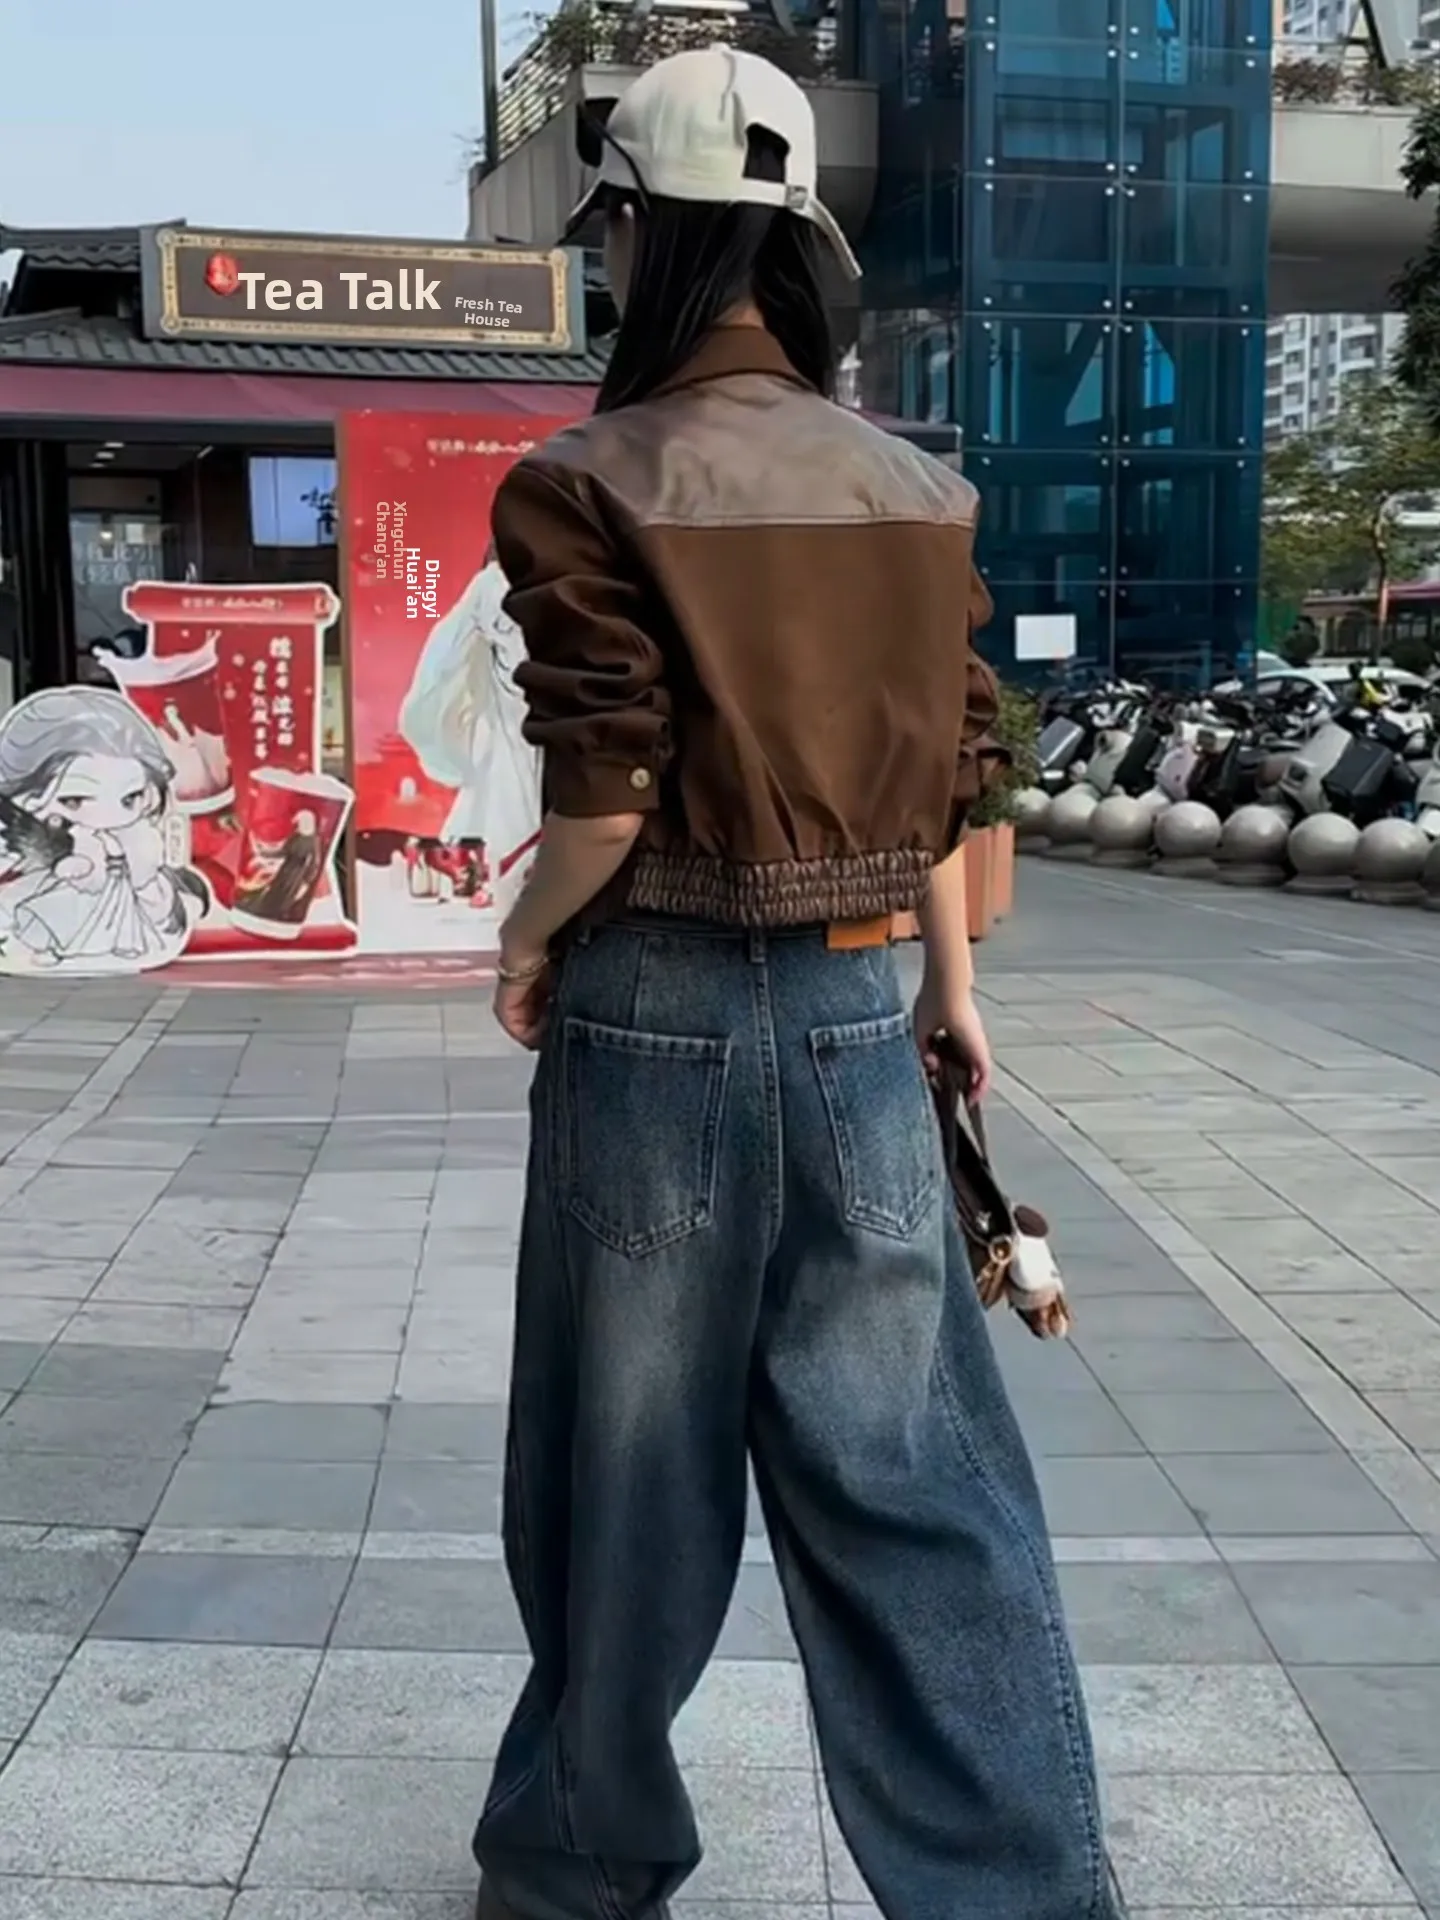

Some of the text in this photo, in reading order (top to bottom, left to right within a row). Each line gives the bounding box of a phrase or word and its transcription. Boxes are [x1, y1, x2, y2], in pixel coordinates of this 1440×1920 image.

[237, 268, 442, 311] Tea Talk
[454, 296, 523, 315] Fresh Tea
[464, 312, 511, 328] House
[374, 501, 390, 579] Chang'an
[391, 501, 407, 580] Xingchun
[406, 548, 421, 618] Huai'an
[422, 560, 440, 618] Dingyi
